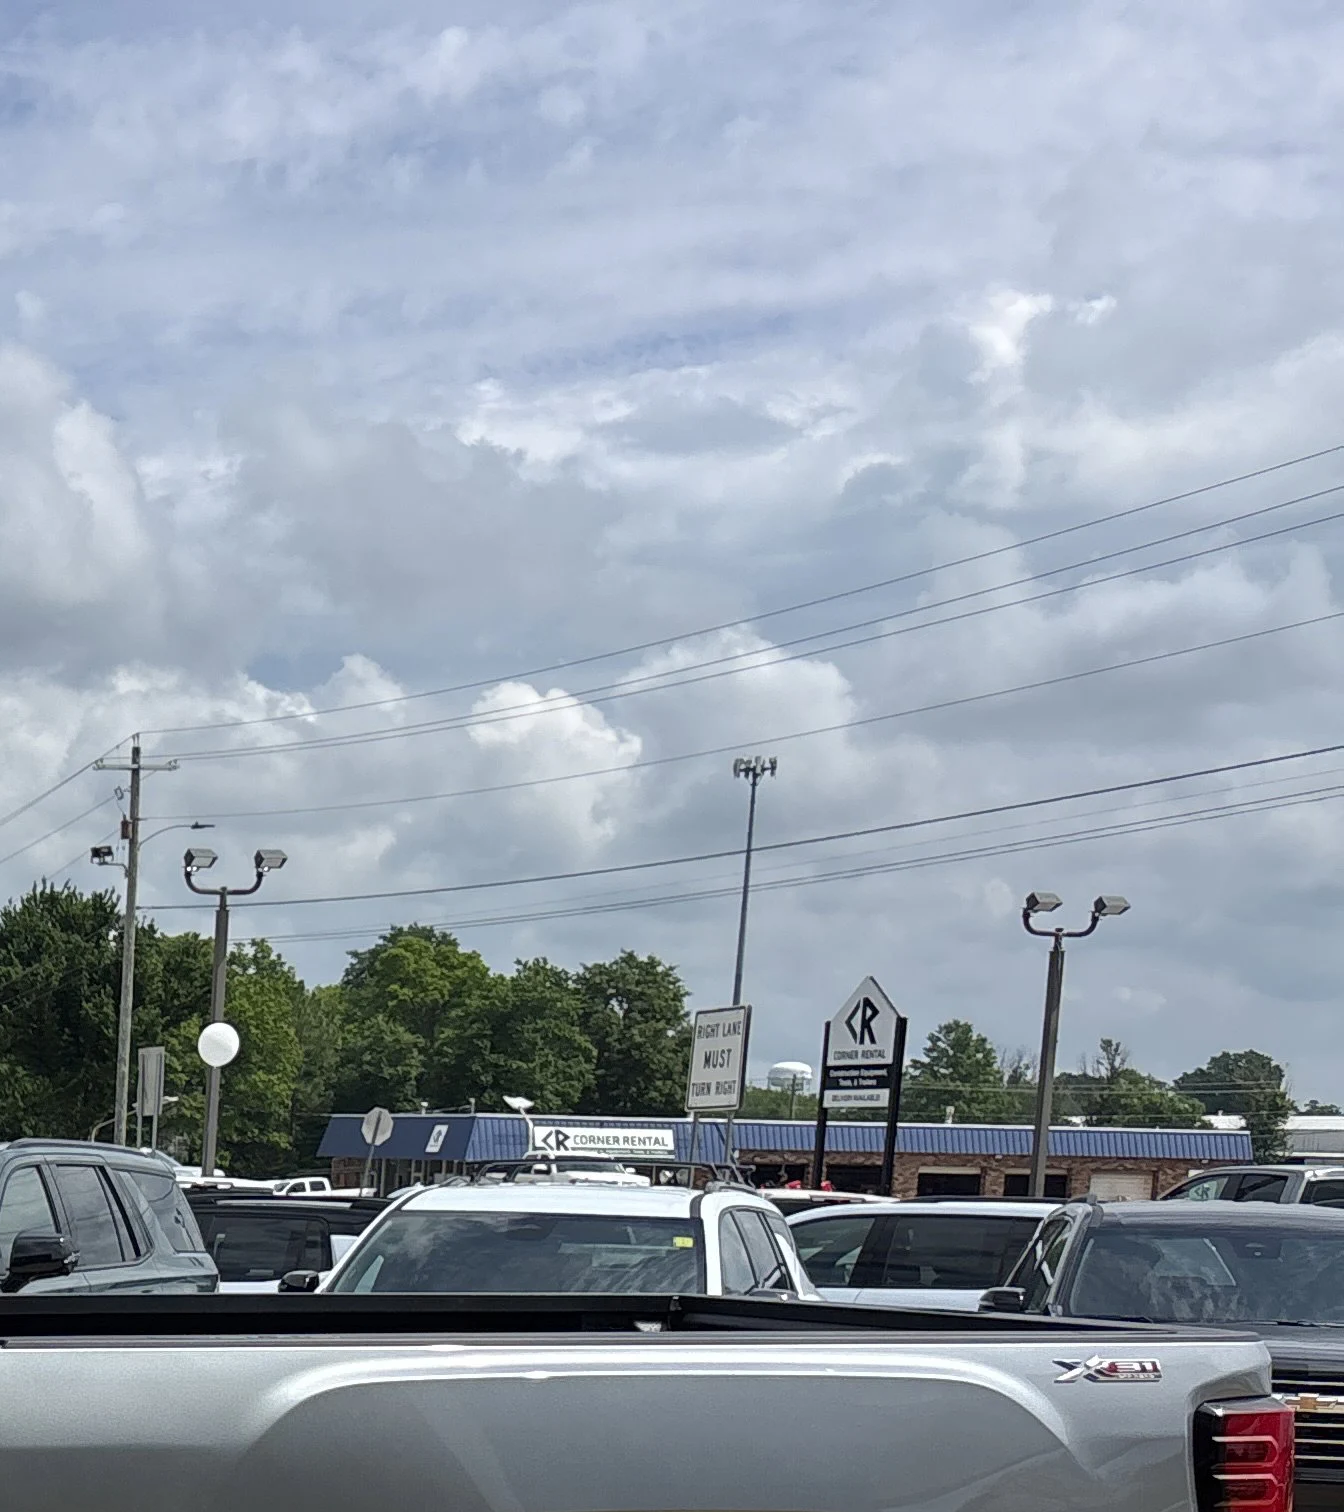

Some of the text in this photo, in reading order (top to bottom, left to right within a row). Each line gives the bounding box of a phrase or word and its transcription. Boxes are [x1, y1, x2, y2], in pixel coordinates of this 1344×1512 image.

[696, 1020, 742, 1040] RIGHT LANE
[703, 1048, 733, 1070] MUST
[833, 1048, 886, 1061] CORNER RENTAL
[691, 1080, 737, 1098] TURN RIGHT
[573, 1133, 620, 1147] CORNER
[623, 1134, 669, 1148] RENTAL
